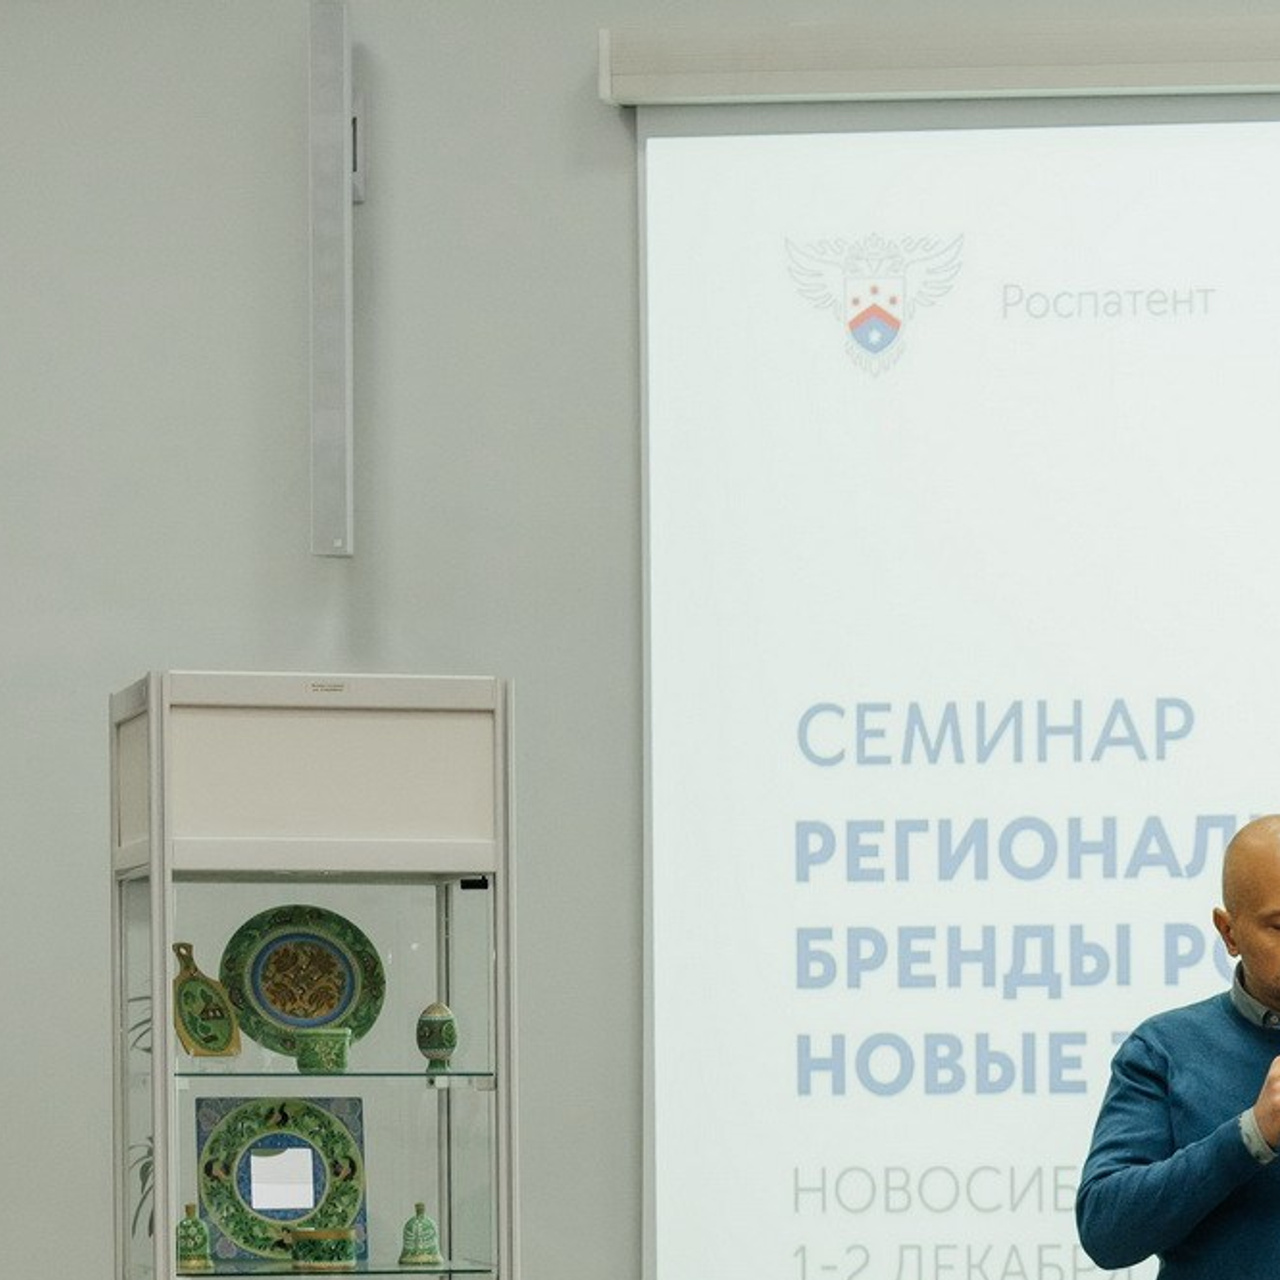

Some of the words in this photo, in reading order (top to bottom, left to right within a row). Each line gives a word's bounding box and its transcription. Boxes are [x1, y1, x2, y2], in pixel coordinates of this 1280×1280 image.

[1002, 283, 1216, 320] Роспатент
[796, 697, 1196, 768] СЕМИНАР
[795, 923, 1132, 1001] БРЕНДЫ
[796, 1031, 1088, 1098] НОВЫЕ
[792, 1164, 1078, 1215] НОВОСИБ
